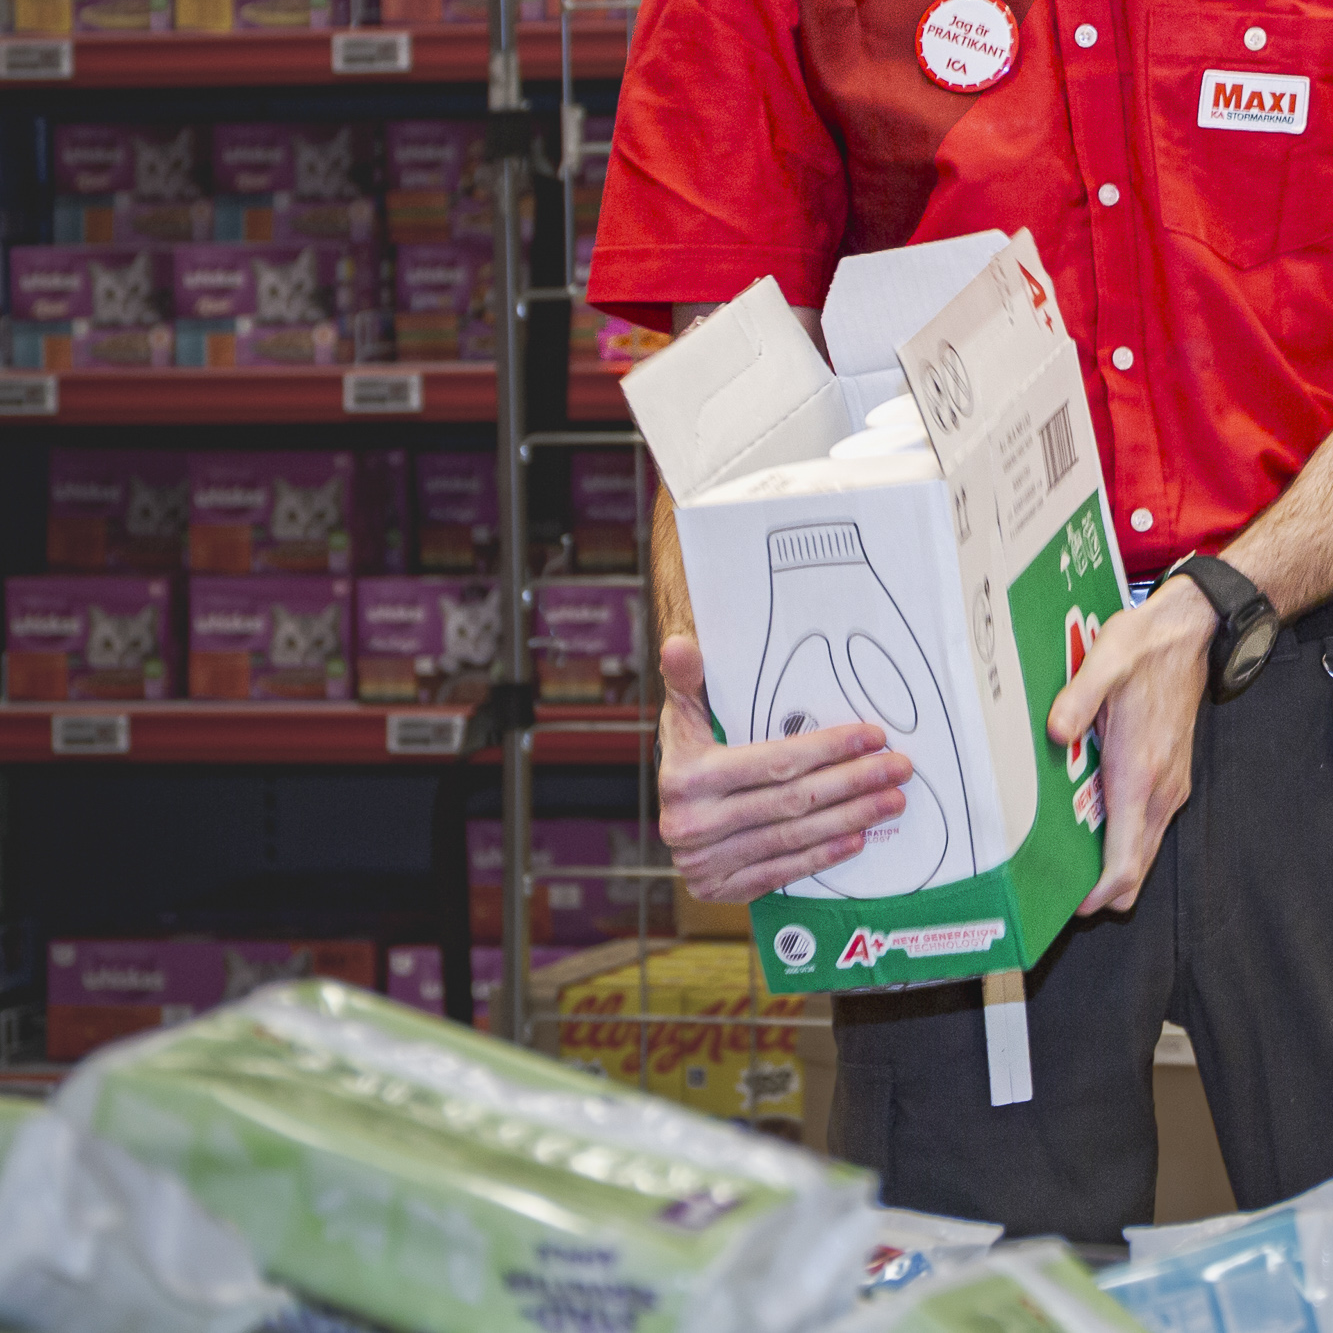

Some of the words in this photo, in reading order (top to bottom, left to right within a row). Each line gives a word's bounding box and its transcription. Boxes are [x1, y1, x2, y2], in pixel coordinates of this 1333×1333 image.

[949, 15, 973, 35] Jag
[975, 23, 991, 38] är
[926, 24, 1006, 60] PRAKTIKANT
[946, 57, 968, 76] ICA
[1212, 82, 1298, 115] MAXI
[1226, 112, 1295, 125] STORMARKNAD
[892, 933, 919, 946] NEW
[923, 927, 998, 943] GENERATION
[906, 938, 987, 954] TECHNOLOGY
